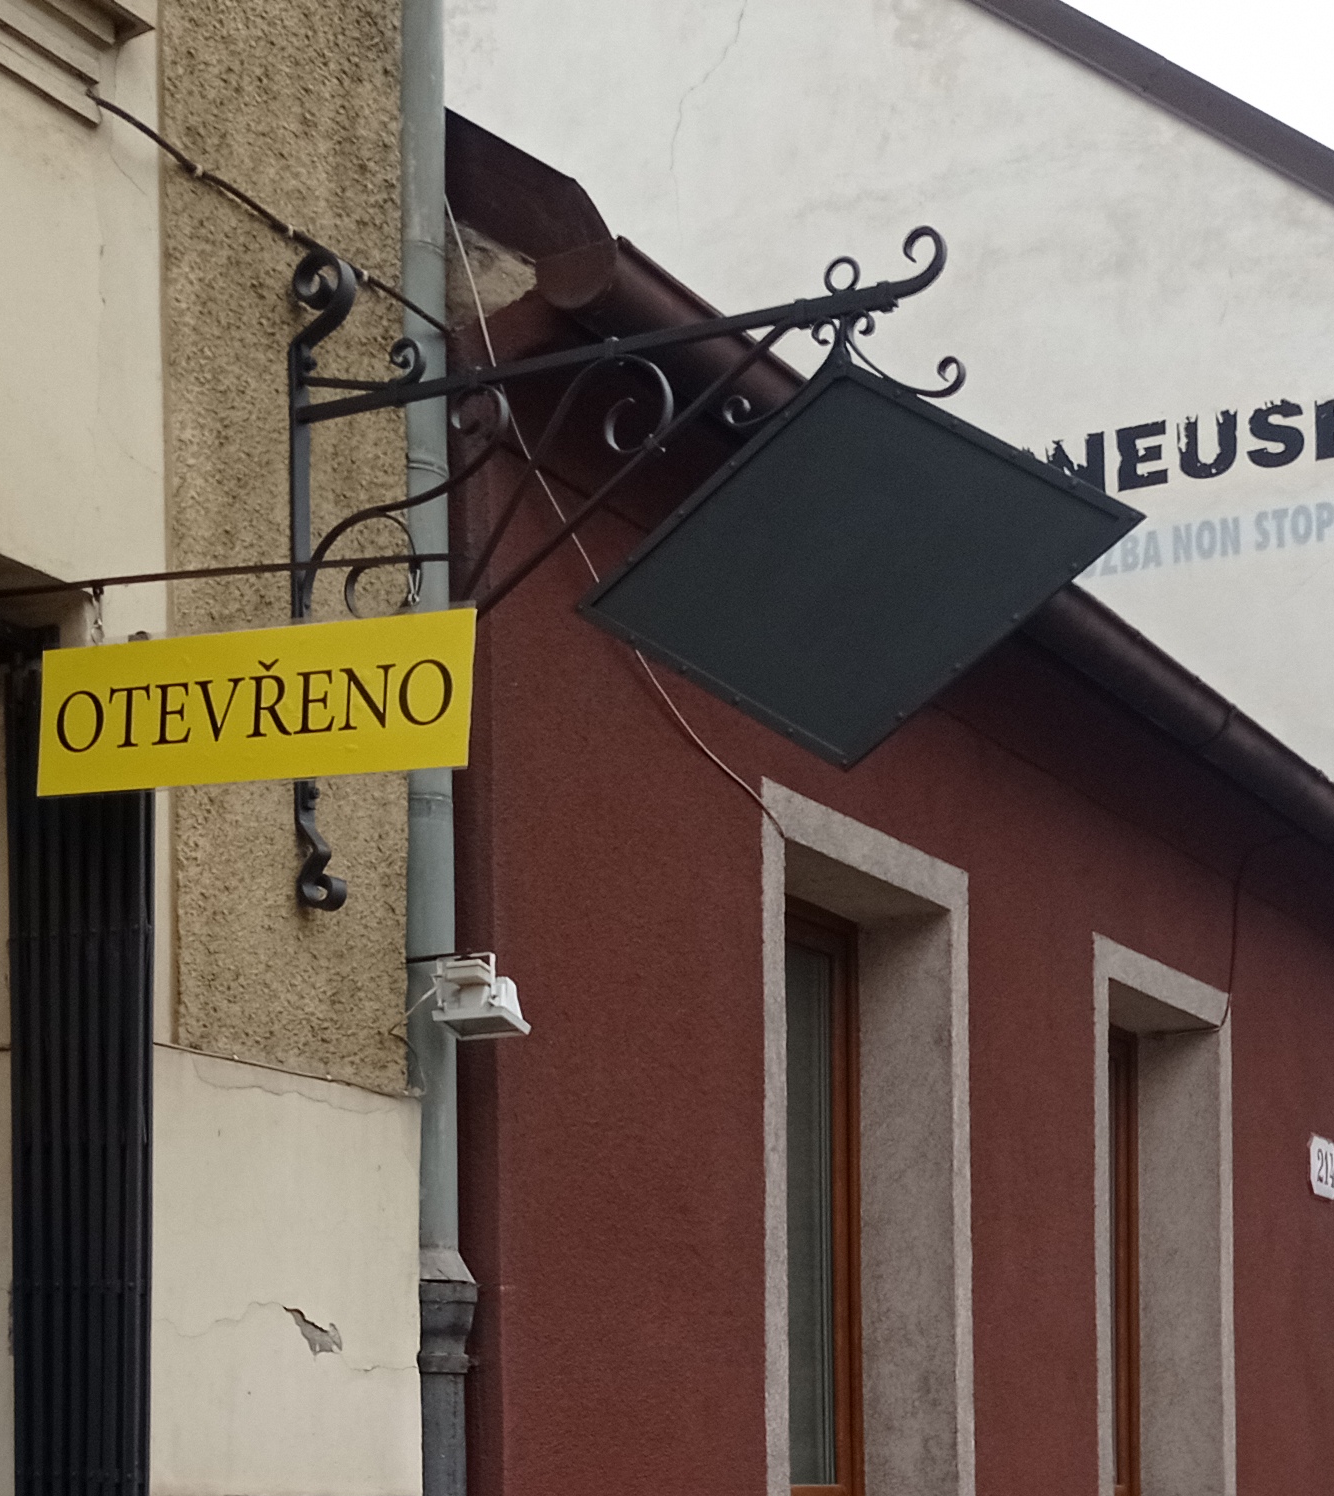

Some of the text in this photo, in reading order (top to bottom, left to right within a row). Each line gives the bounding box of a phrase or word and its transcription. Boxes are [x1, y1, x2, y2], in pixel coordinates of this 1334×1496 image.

[1172, 516, 1241, 564] NON
[1254, 502, 1334, 550] STOP
[56, 658, 453, 752] OTEVŘENO
